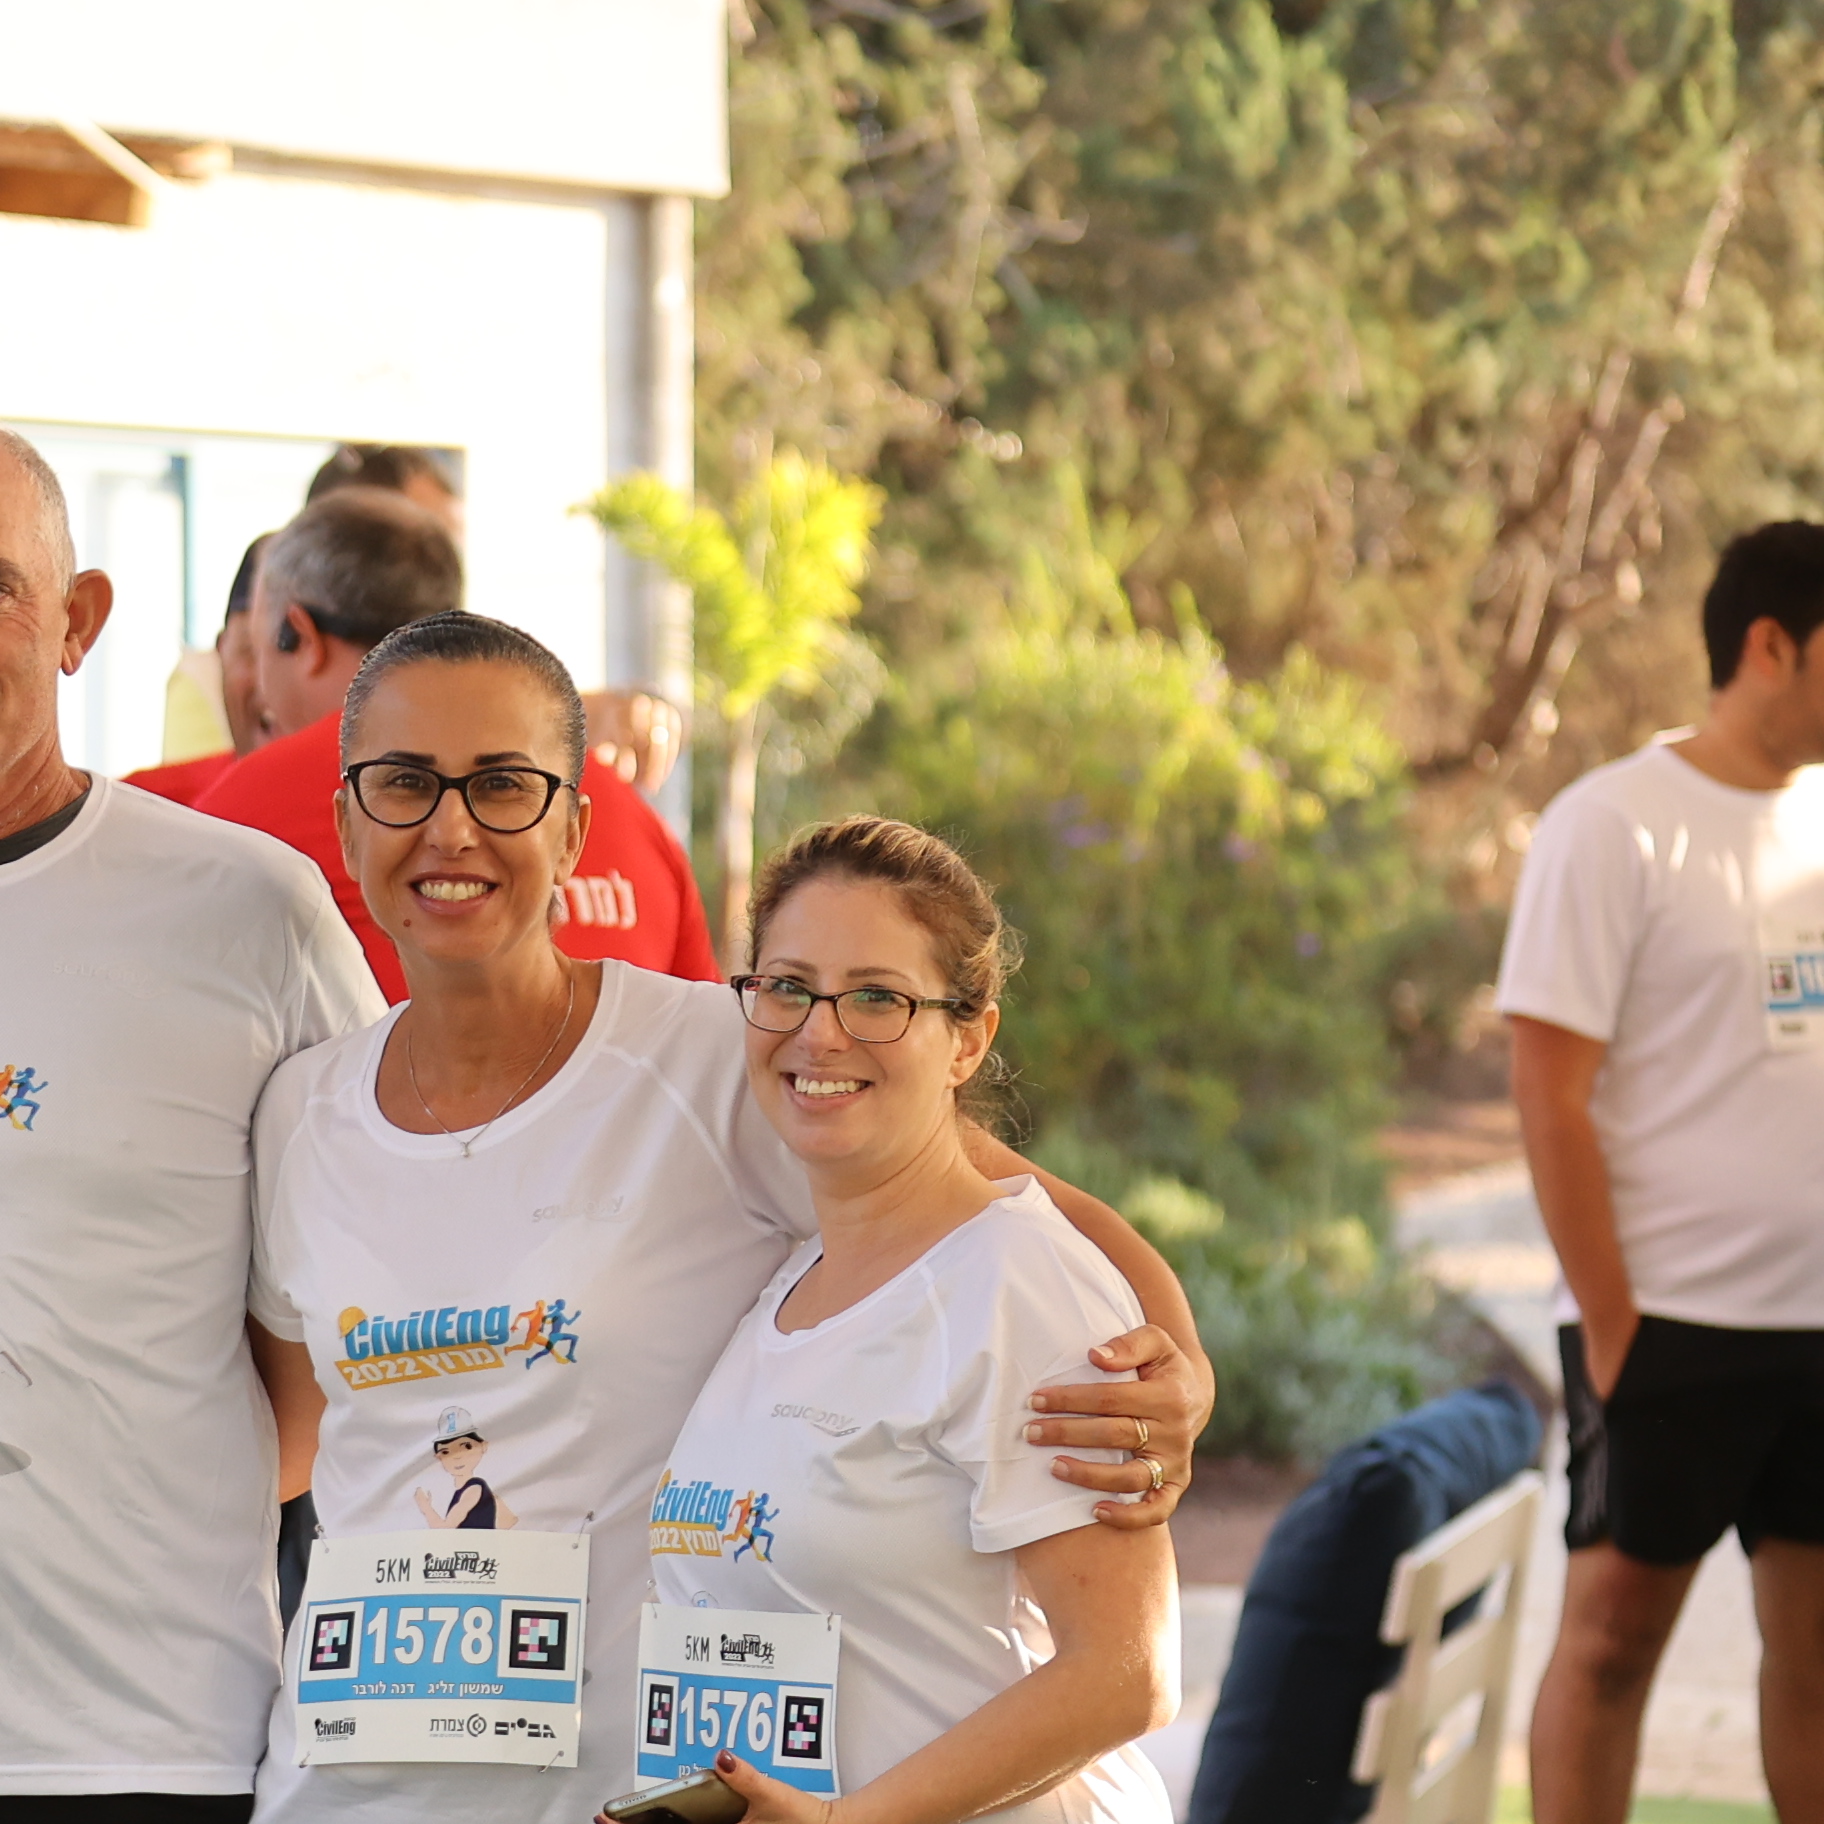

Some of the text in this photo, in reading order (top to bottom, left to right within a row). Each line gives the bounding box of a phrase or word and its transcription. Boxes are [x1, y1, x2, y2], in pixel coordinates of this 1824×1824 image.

[344, 1304, 511, 1361] CivilEng
[343, 1347, 496, 1386] מרוץ 2022
[653, 1480, 734, 1531] CivilEng
[681, 1528, 719, 1555] מרוץ
[375, 1557, 411, 1583] 5KM
[367, 1606, 495, 1665] 1578
[685, 1635, 710, 1662] 5KM
[352, 1680, 504, 1697] שמשון זליג דנה לורבר
[316, 1719, 356, 1736] CivilEng
[429, 1718, 465, 1732] צמרת
[680, 1686, 774, 1752] 1576
